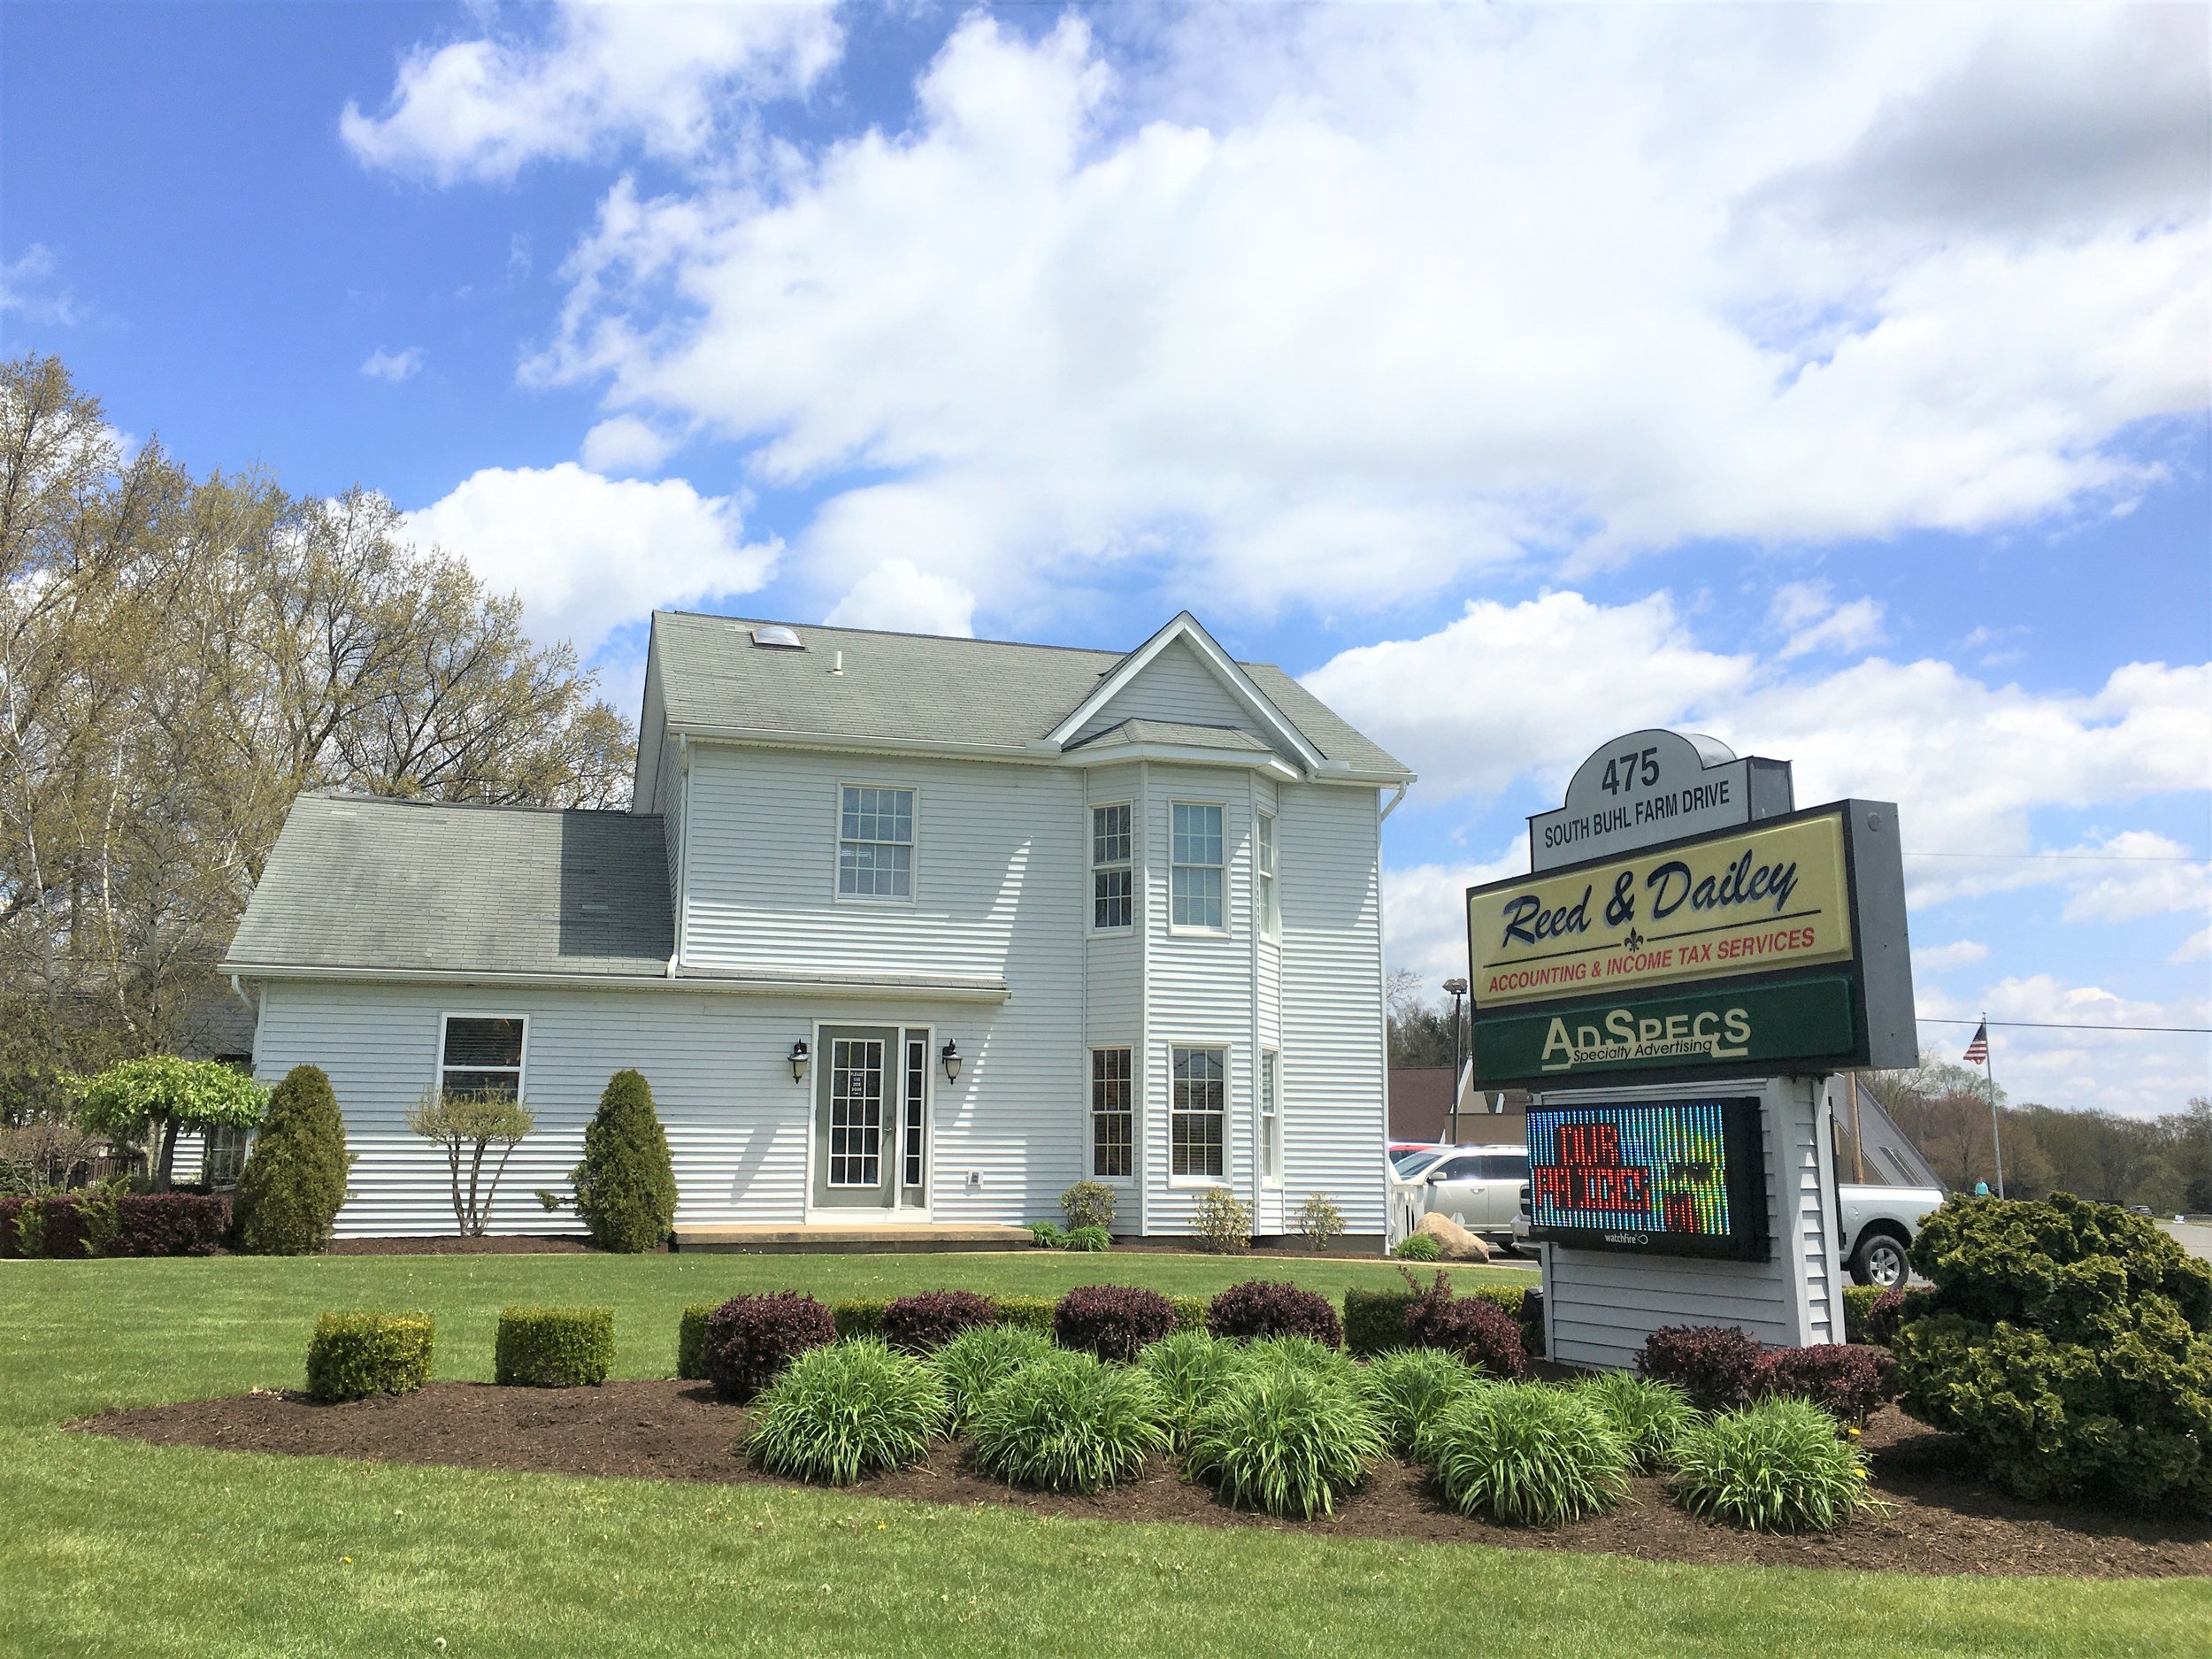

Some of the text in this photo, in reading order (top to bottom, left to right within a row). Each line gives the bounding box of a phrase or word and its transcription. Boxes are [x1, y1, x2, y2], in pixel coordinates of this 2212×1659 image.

[1602, 747, 1660, 795] 475
[1545, 780, 1731, 849] SOUTH BUHL FARM DRIVE
[1502, 849, 1799, 948] Reed & Dailey
[1488, 926, 1816, 993] ACCOUNTING & INCOME TAX SERVICES
[1573, 1039, 1713, 1063] Specialty Advertising
[1560, 1125, 1618, 1166] OUR
[1604, 1233, 1637, 1244] watchfire
